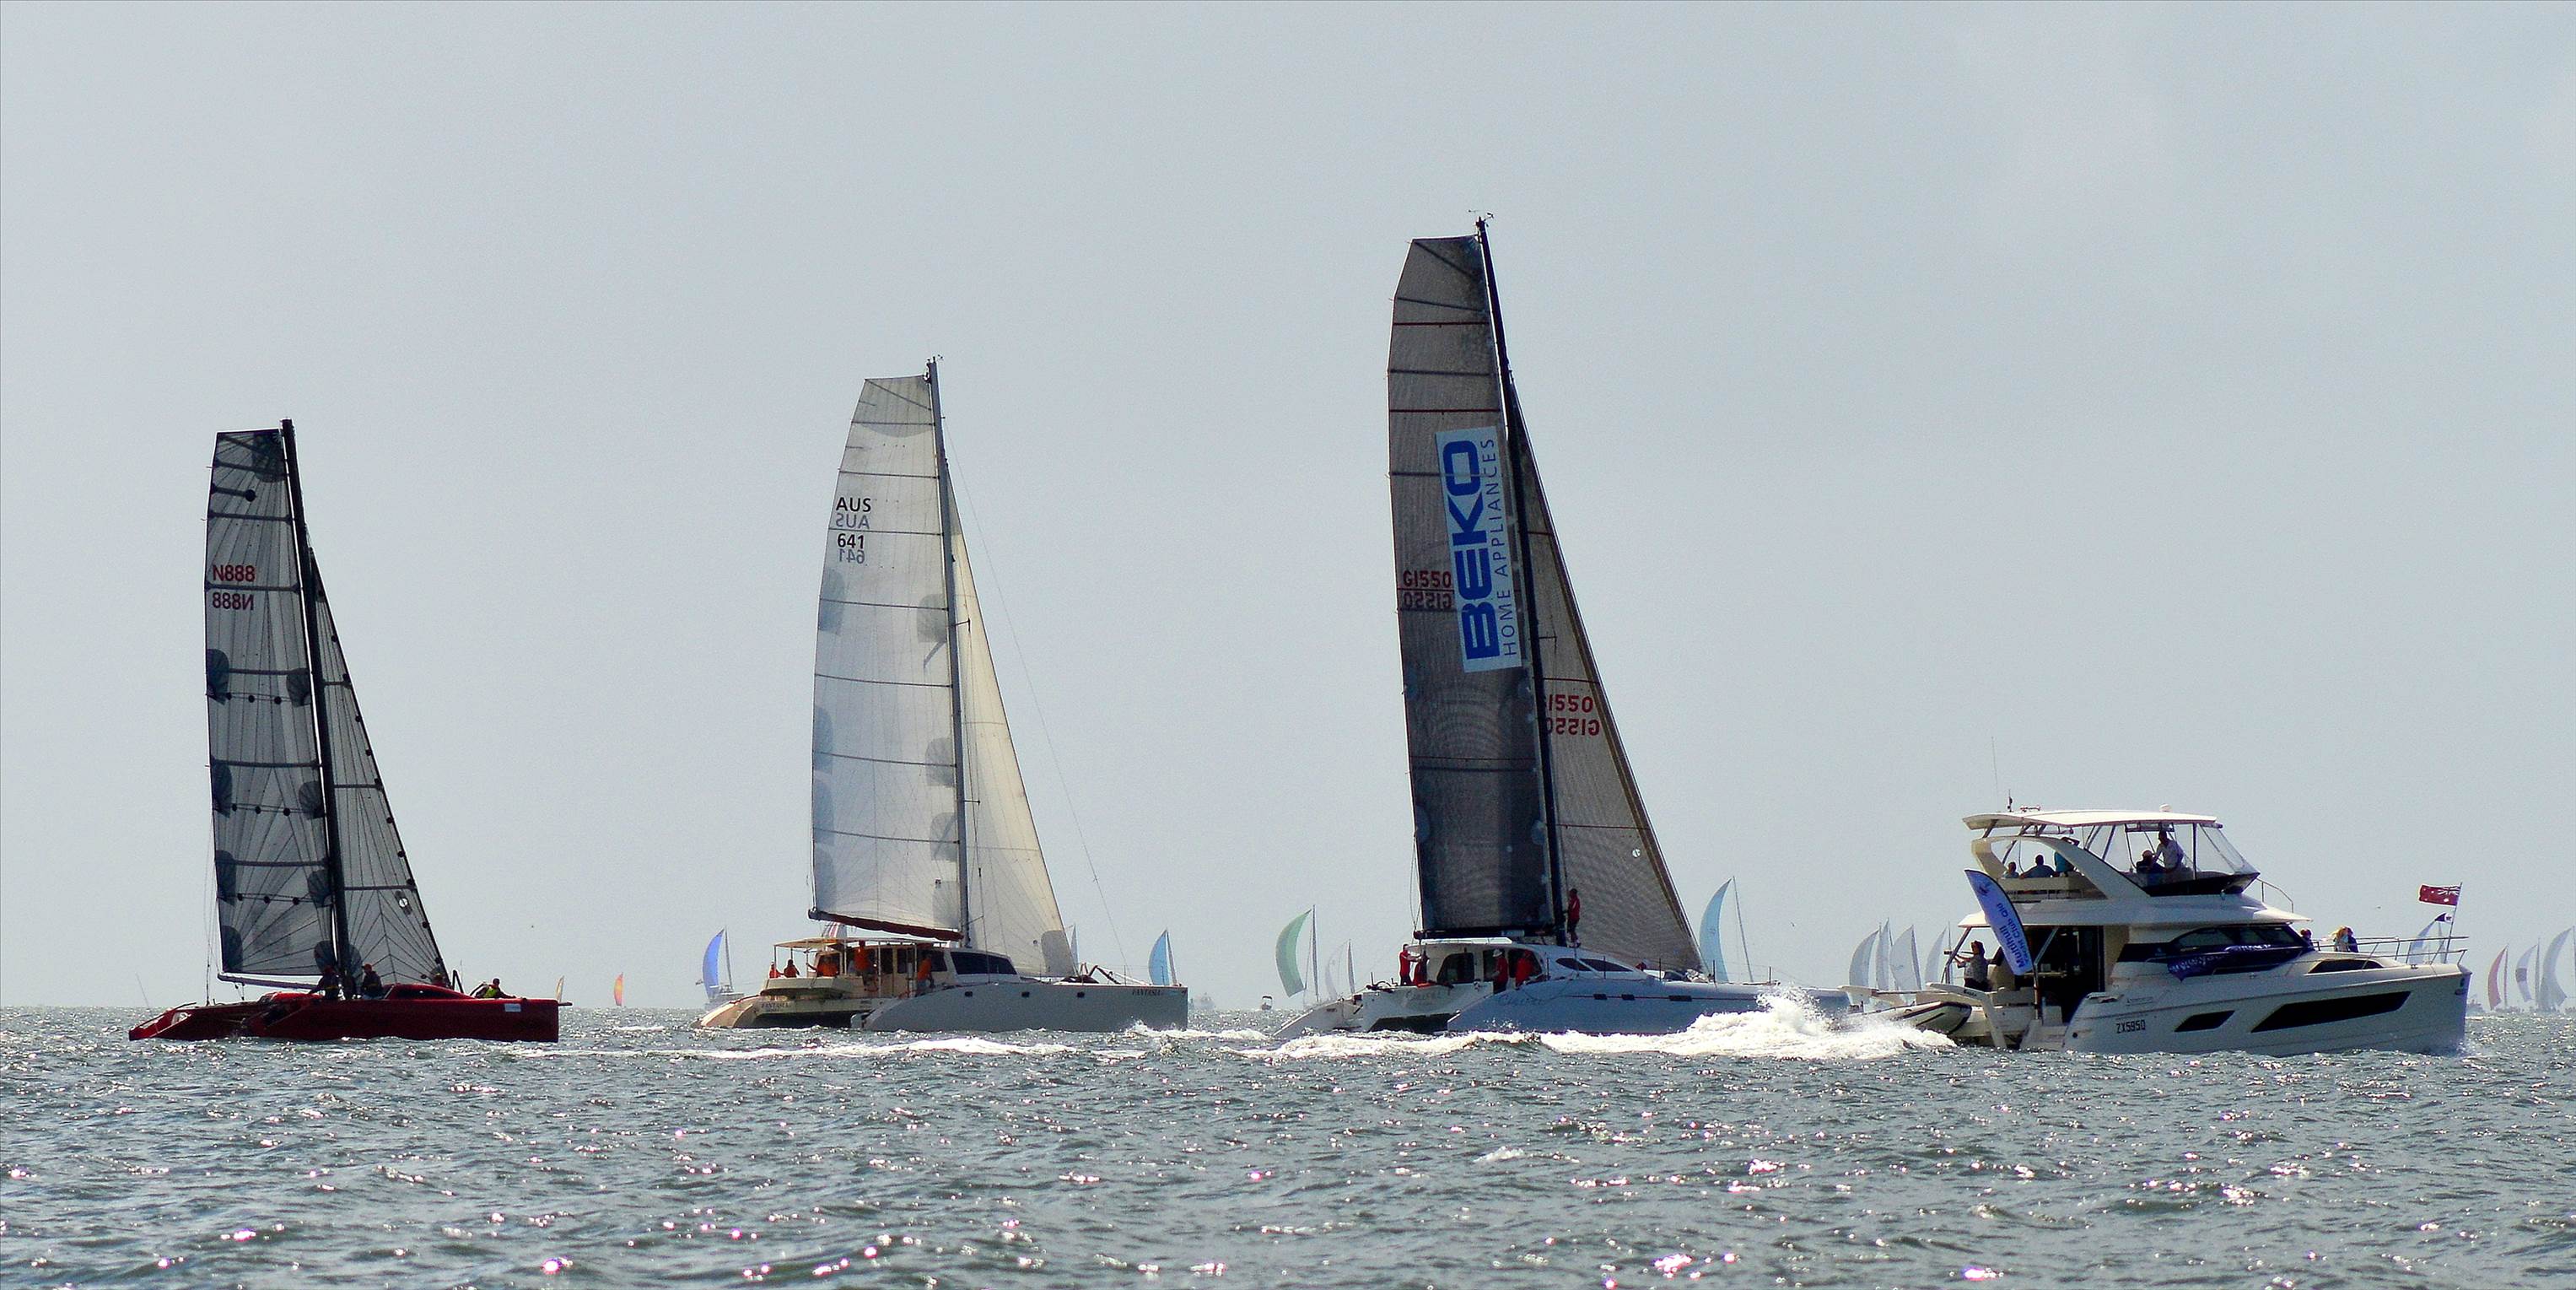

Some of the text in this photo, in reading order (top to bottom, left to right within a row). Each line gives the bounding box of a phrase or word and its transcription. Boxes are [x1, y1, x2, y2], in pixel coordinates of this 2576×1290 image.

[835, 497, 871, 512] AUS
[838, 533, 865, 549] 641
[1442, 440, 1501, 660] BEKO
[1480, 438, 1517, 656] HOME APPLIANCES
[212, 564, 256, 582] N888
[2007, 918, 2020, 938] Club
[1999, 926, 2026, 968] Multihull
